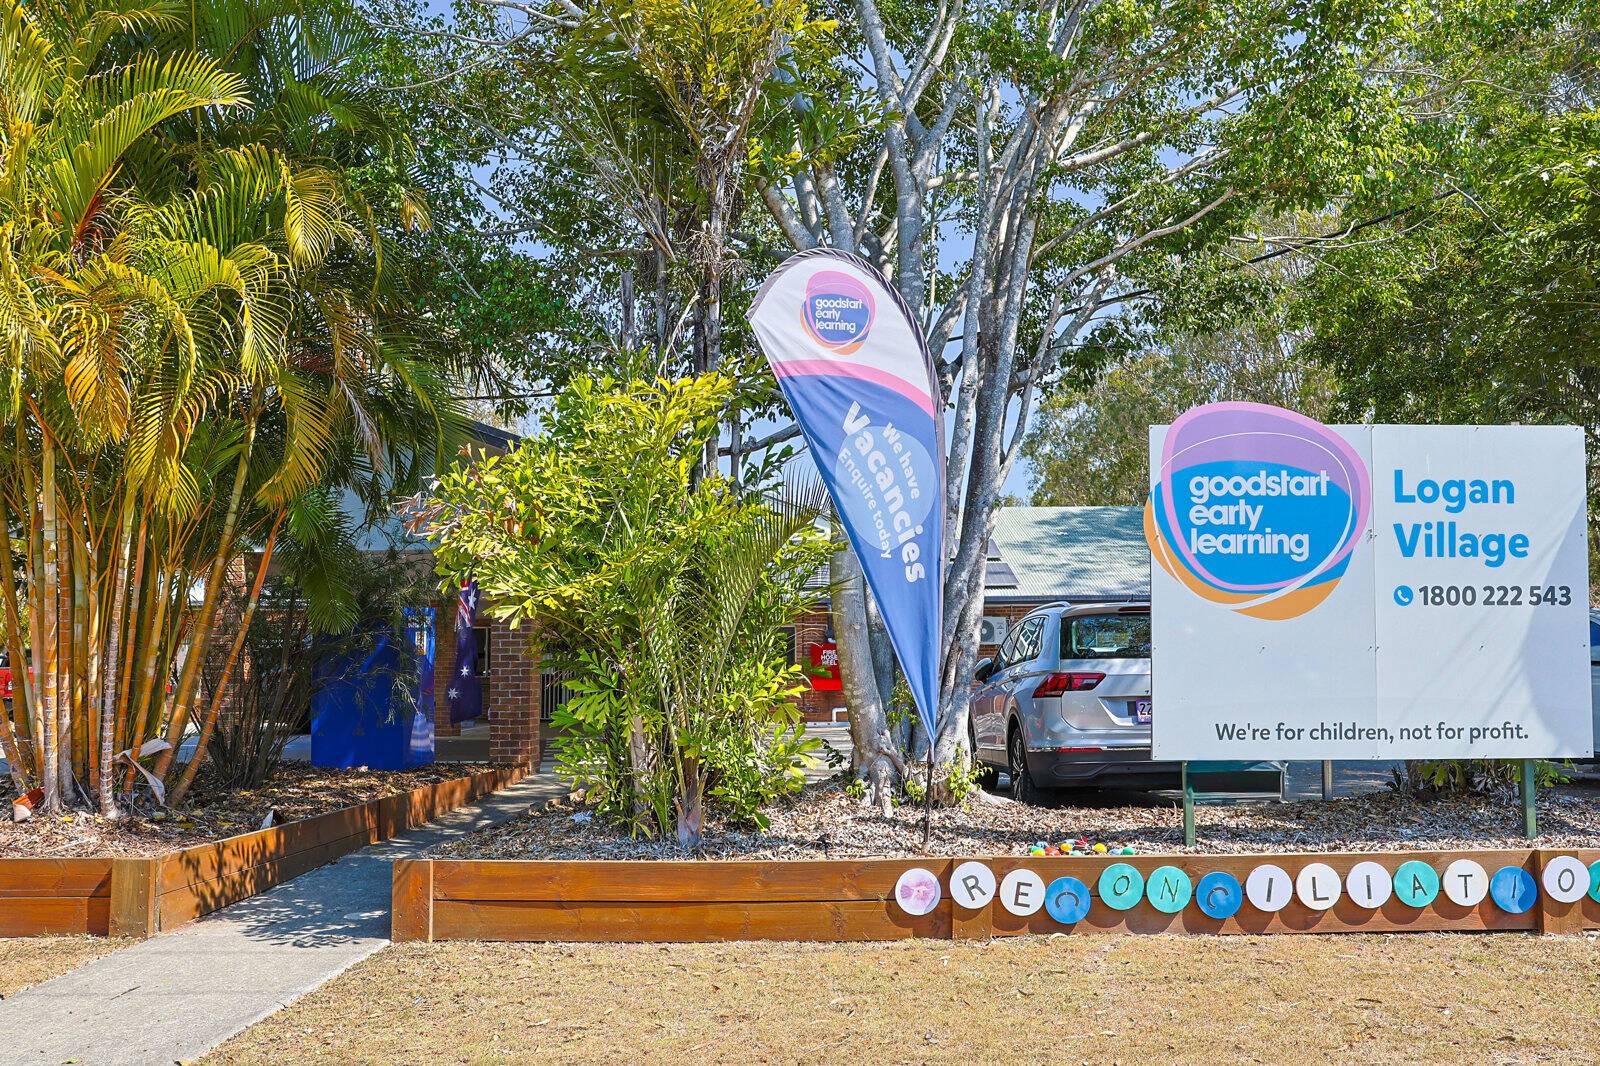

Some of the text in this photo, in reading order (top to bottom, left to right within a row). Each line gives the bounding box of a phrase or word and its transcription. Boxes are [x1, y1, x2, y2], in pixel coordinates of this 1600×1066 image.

[815, 298, 863, 309] goodstart
[815, 309, 841, 321] early
[815, 319, 856, 333] learning
[882, 421, 919, 500] We have
[837, 447, 892, 559] Enquire today
[842, 400, 926, 583] Vacancies
[1189, 470, 1330, 504] goodstart
[1394, 469, 1515, 514] Logan
[1189, 499, 1263, 531] early
[1190, 527, 1310, 562] learning
[1393, 521, 1530, 568] Village
[1418, 585, 1572, 606] 1800 222 543
[1215, 721, 1530, 743] We're for children, not for profit.
